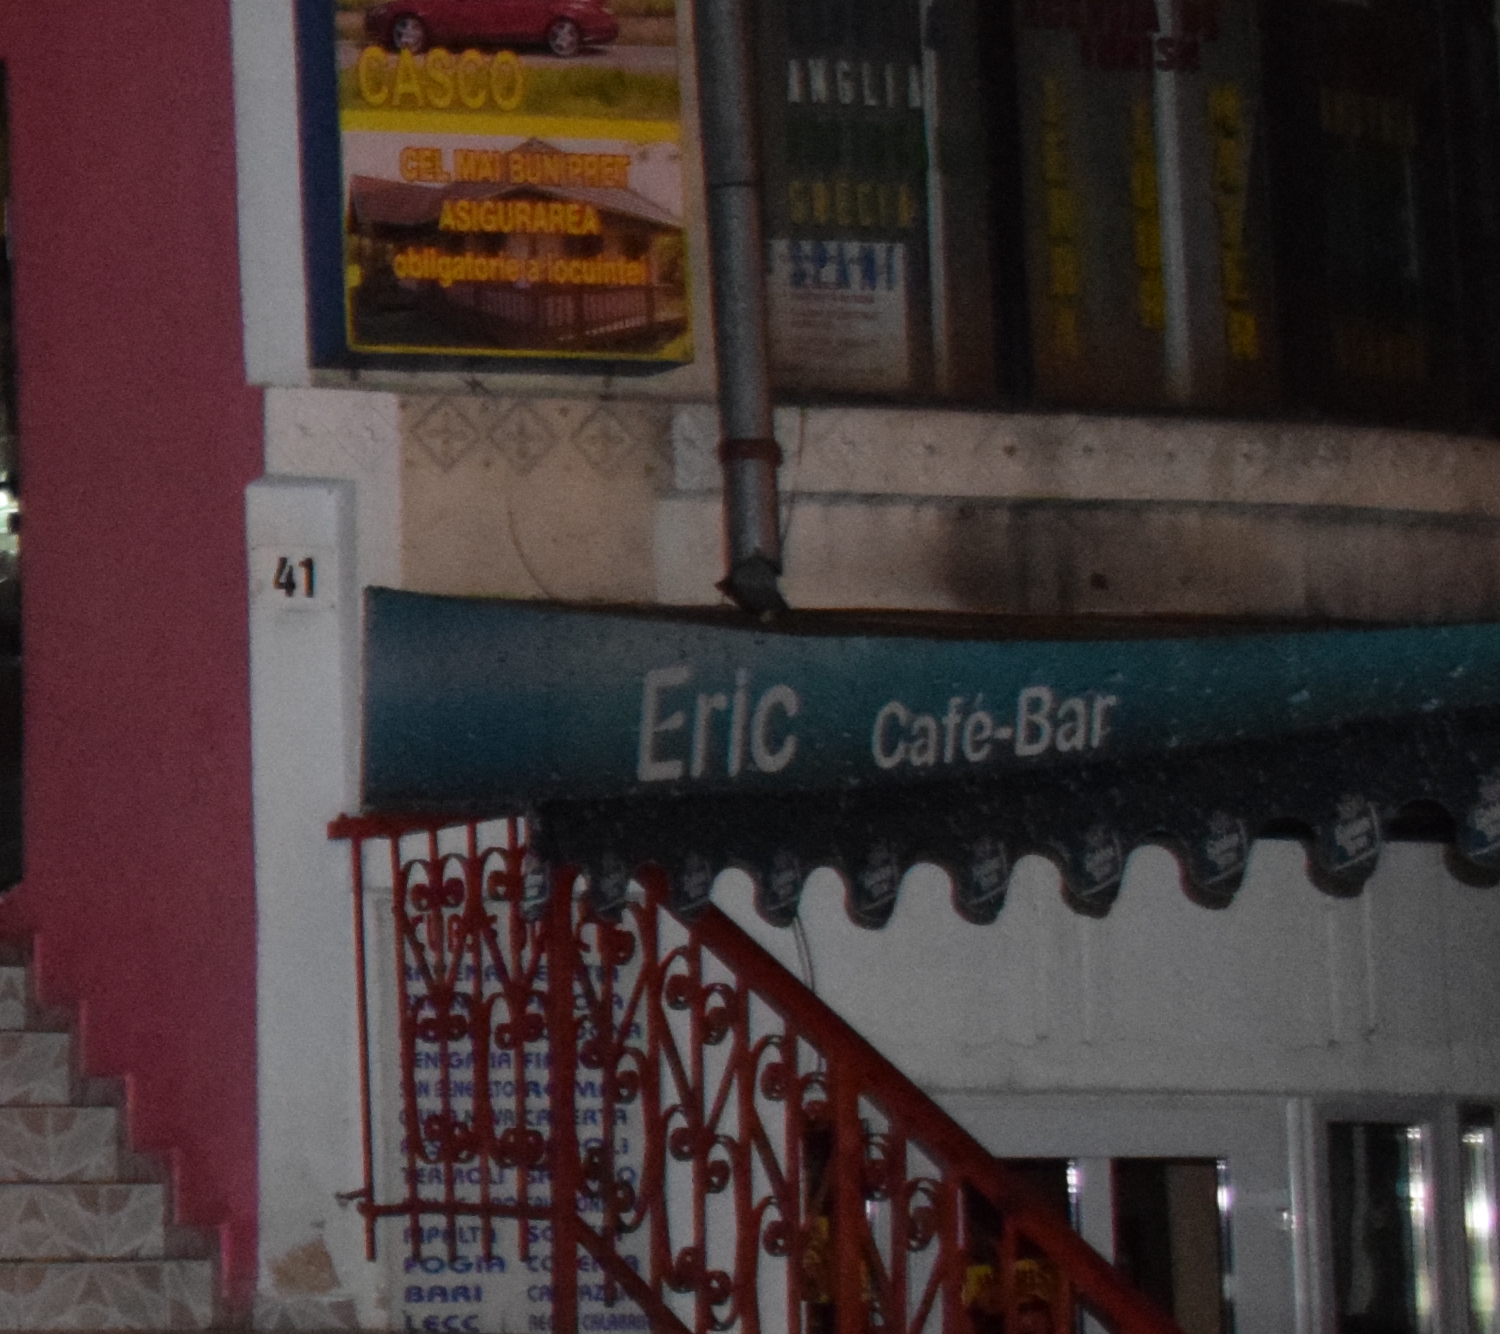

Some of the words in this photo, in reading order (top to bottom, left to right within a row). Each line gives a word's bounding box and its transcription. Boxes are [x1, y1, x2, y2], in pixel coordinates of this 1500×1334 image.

[358, 45, 525, 111] CASCO
[438, 199, 602, 237] ASIGURAREA
[273, 555, 316, 597] 41
[638, 667, 800, 781] Eric
[871, 683, 1118, 772] Café-Bar
[404, 1285, 483, 1303] BARI
